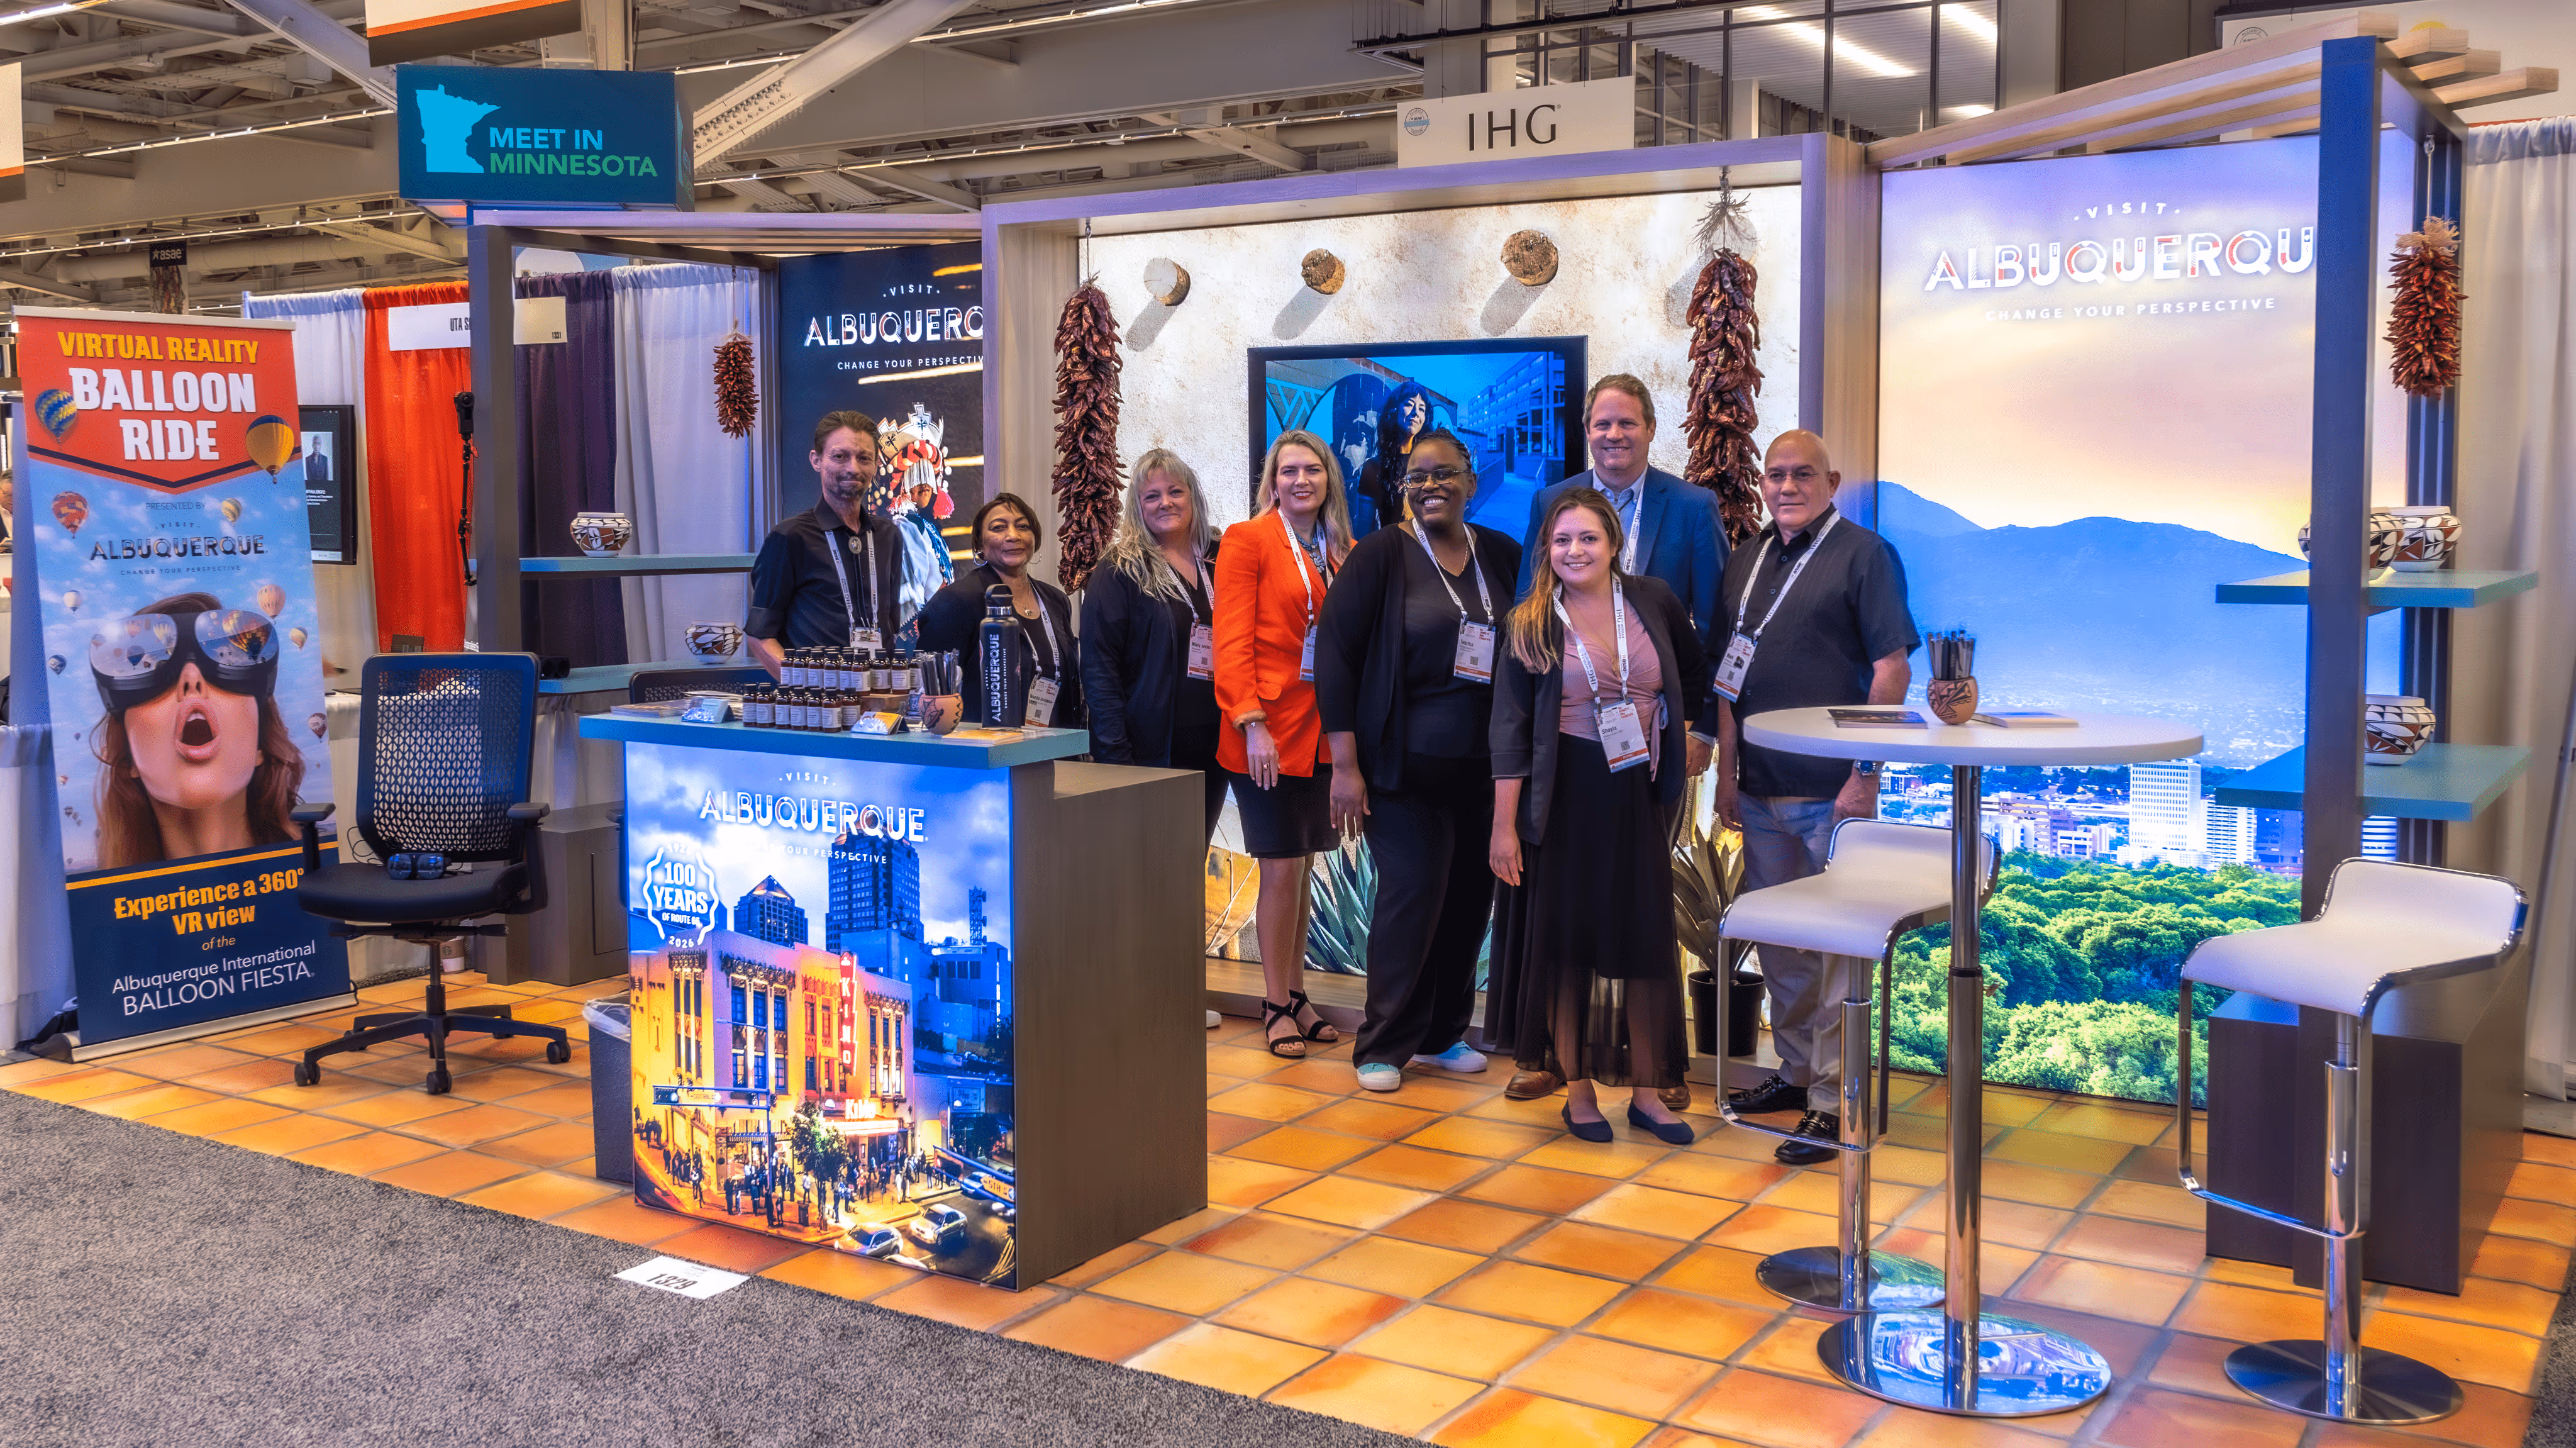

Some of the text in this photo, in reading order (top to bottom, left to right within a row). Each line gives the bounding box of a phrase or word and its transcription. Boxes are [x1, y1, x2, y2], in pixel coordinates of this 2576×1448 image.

[489, 127, 603, 150] MEET IN
[1469, 104, 1556, 152] IHG
[490, 152, 658, 177] MINNESOTA
[2087, 202, 2167, 219] VISIT
[160, 248, 182, 260] asae
[890, 284, 932, 296] VISIT
[1985, 298, 2275, 321] CHANGE YOUR PERSPECTIVE
[450, 318, 463, 331] UTA
[57, 331, 259, 364] VIRTUAL REALITY
[838, 360, 879, 370] CHANGE
[885, 359, 913, 368] YOUR
[69, 367, 256, 413] BALLOON
[119, 419, 219, 460] RIDE
[145, 501, 206, 510] PRESENTED BY
[90, 535, 265, 560] ALBUQUERQUE
[989, 634, 1001, 722] ALBUQUERQUE
[1601, 726, 1618, 734] Shayla
[786, 772, 829, 785] VISIT
[699, 790, 924, 842] ALBUQUERQUE
[782, 845, 808, 856] YOUR
[814, 848, 887, 864] PERSPECTIVE
[664, 862, 696, 887] 100
[114, 868, 304, 920] Experience a 360°
[653, 885, 708, 914] YEARS
[172, 905, 255, 935] VR view
[662, 912, 670, 922] OF
[670, 913, 691, 925] ROUTE
[201, 935, 236, 950] of the
[669, 935, 694, 949] 2026
[112, 939, 316, 994] Albuquerque International
[123, 976, 235, 1016] BALLOON
